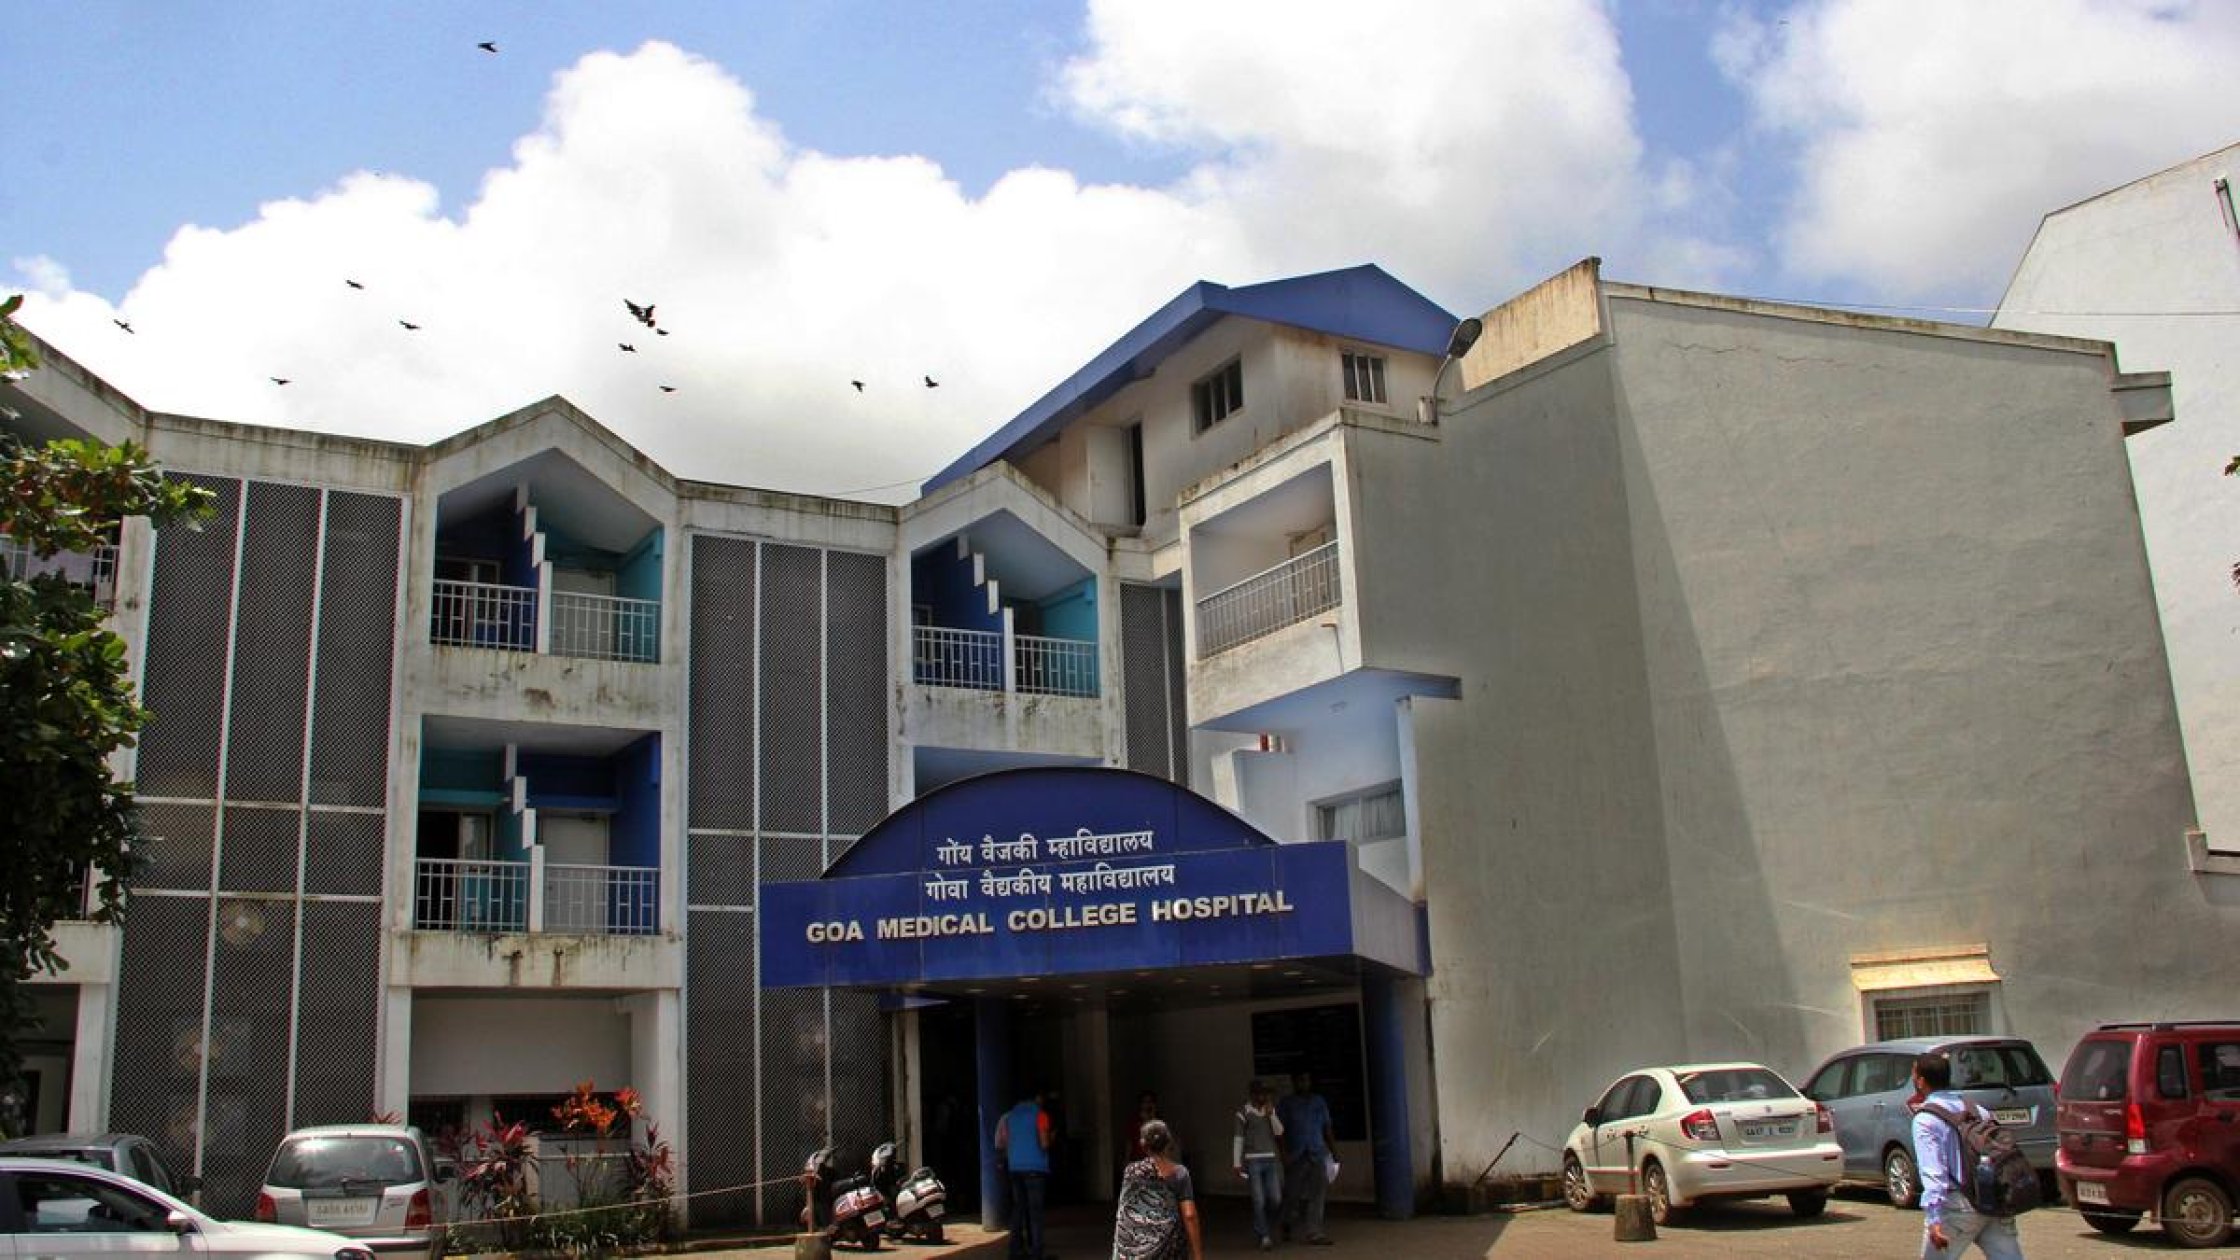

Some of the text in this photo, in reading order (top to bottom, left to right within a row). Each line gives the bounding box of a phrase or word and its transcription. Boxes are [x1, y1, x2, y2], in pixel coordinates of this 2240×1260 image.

[980, 833, 1038, 862] वैजकी
[925, 863, 1175, 900] गोवा वैद्यकीय महाविद्यालय
[806, 890, 1293, 942] GOA MEDICAL COLLEGE HOSPITAL
